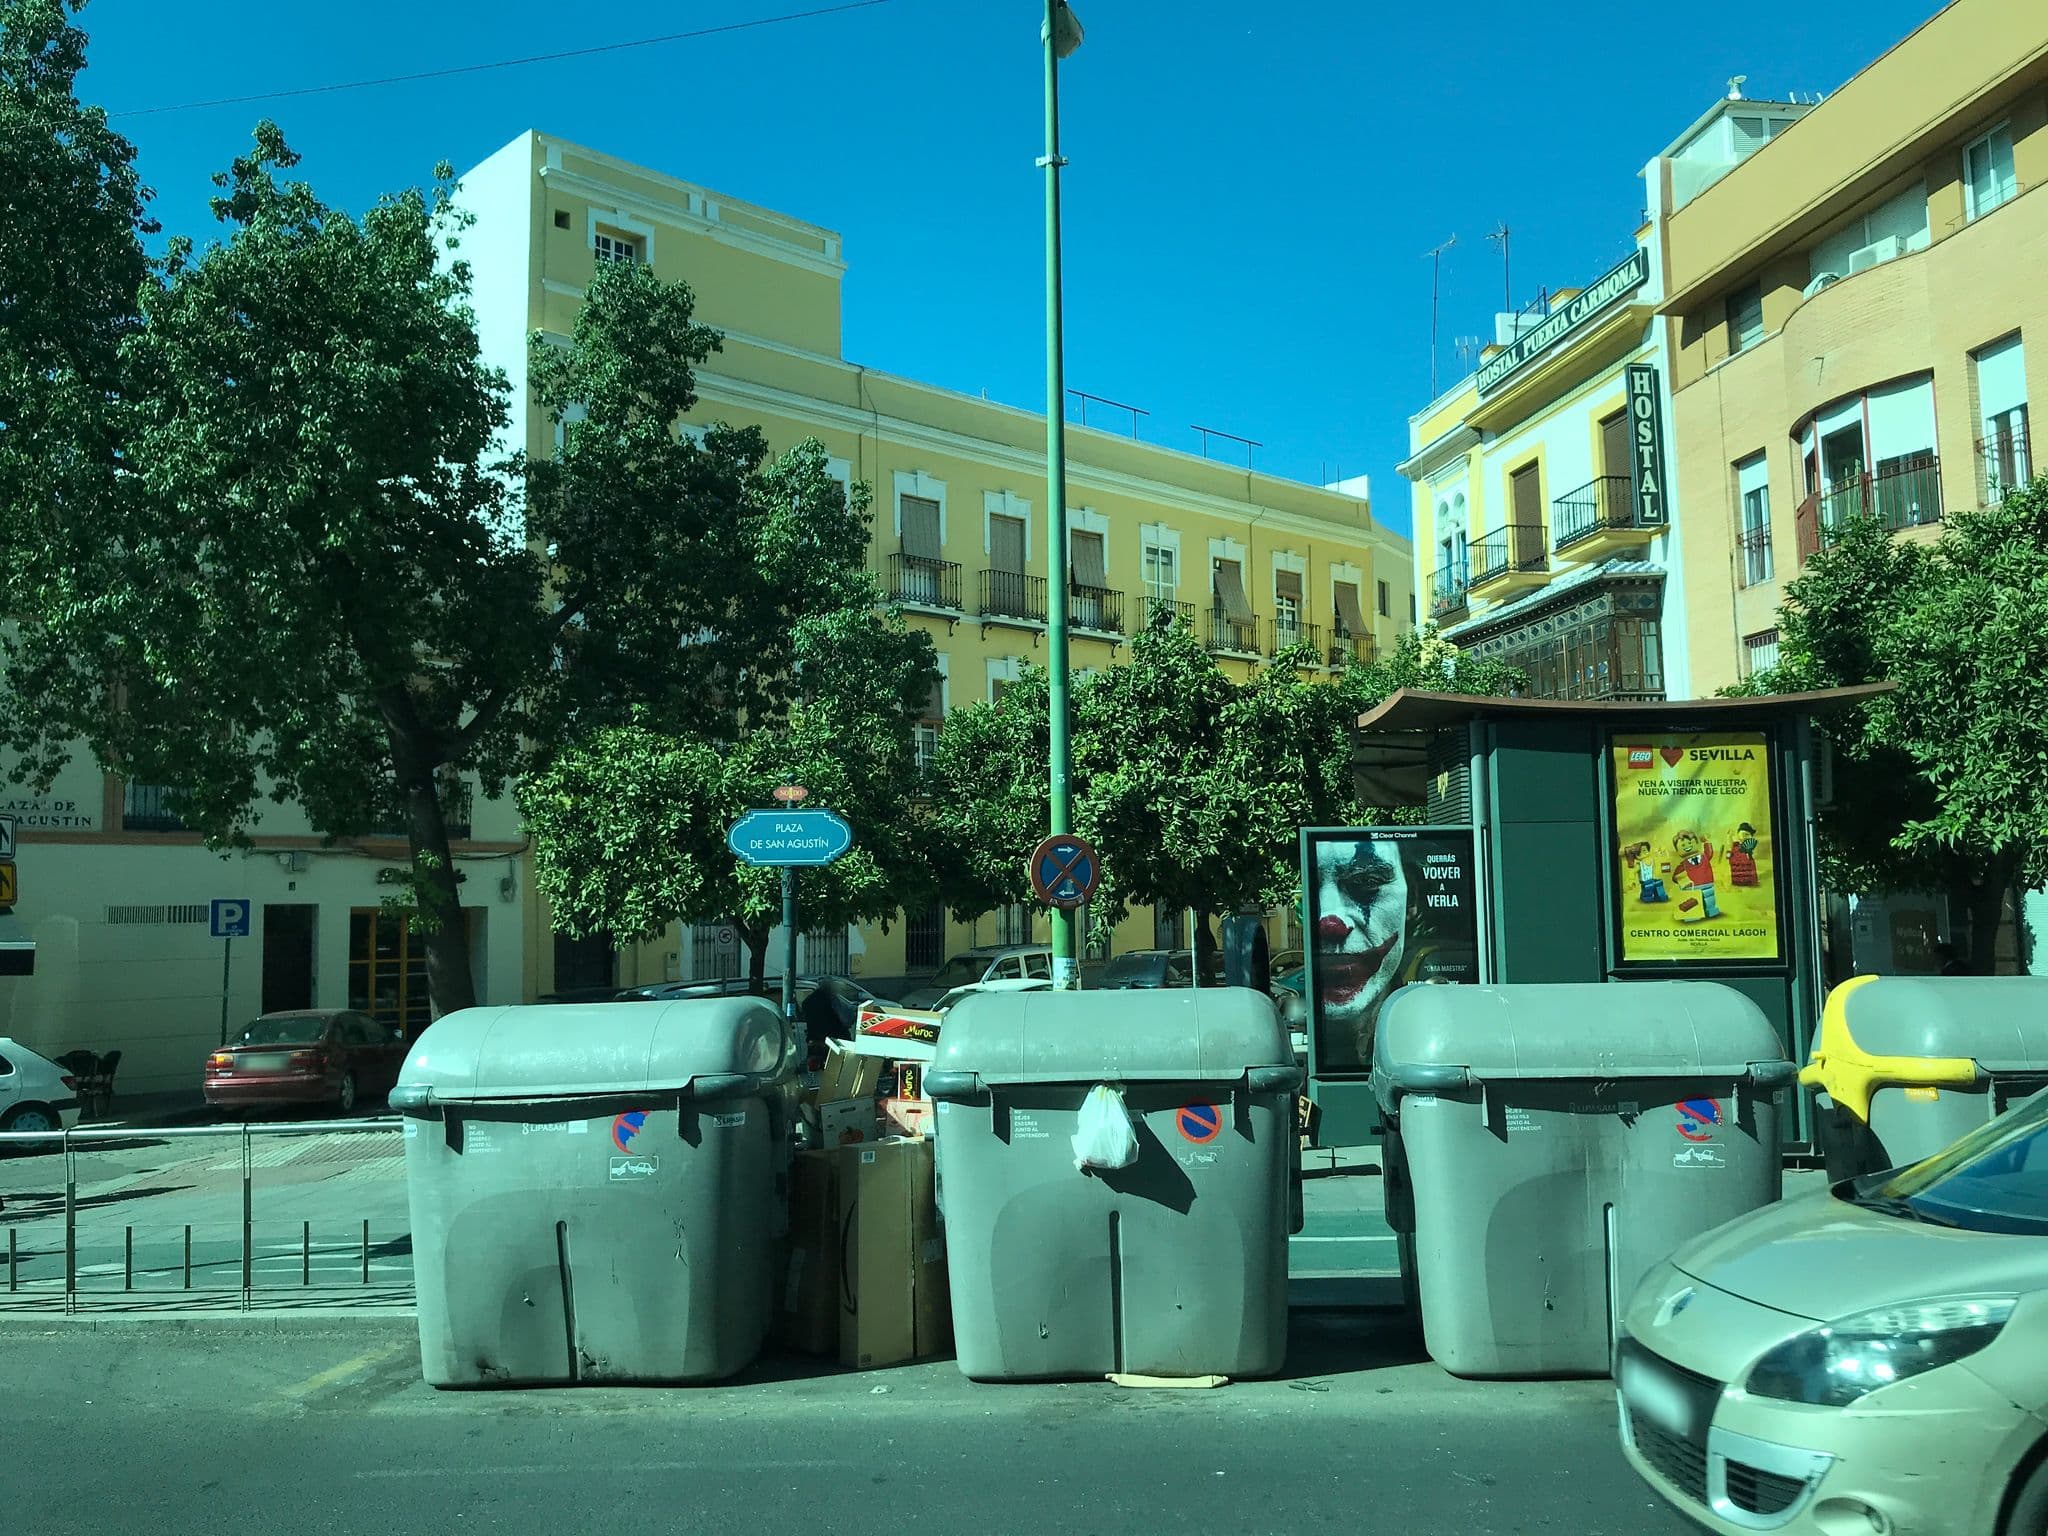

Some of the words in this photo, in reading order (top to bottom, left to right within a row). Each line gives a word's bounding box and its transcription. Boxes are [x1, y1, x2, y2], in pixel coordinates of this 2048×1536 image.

[1478, 347, 1520, 390] HOSTAL
[1522, 316, 1569, 360] PUERTA
[1570, 258, 1640, 321] CARMONA
[1631, 370, 1658, 519] HOSTAL
[1630, 751, 1652, 762] LEGO
[1689, 749, 1755, 761] SEVILLA
[1638, 780, 1658, 788] VEN
[1667, 779, 1702, 787] VISITAR
[1703, 778, 1747, 787] NUESTRA
[1638, 788, 1669, 796] NUEVA
[1672, 787, 1703, 796] TIENDA
[1705, 787, 1718, 795] DE
[1720, 787, 1746, 795] LEGO
[0, 800, 41, 810] AZA
[54, 801, 76, 811] DE
[775, 823, 804, 833] PLAZA
[750, 840, 763, 849] DE
[765, 839, 785, 849] SAN
[786, 836, 829, 849] AGUSTÍN
[1426, 853, 1456, 863] QUERRÁS
[1422, 866, 1461, 880] VOLVER
[1439, 883, 1445, 891] A
[1426, 894, 1459, 908] VERLA
[218, 902, 243, 934] P
[1630, 929, 1670, 938] CENTRO
[1672, 928, 1730, 937] COMERCIAL
[1732, 928, 1767, 937] LAGOH
[903, 1024, 934, 1038] Maroc
[905, 1069, 915, 1100] Maroc
[530, 1123, 568, 1132] LIPASAM
